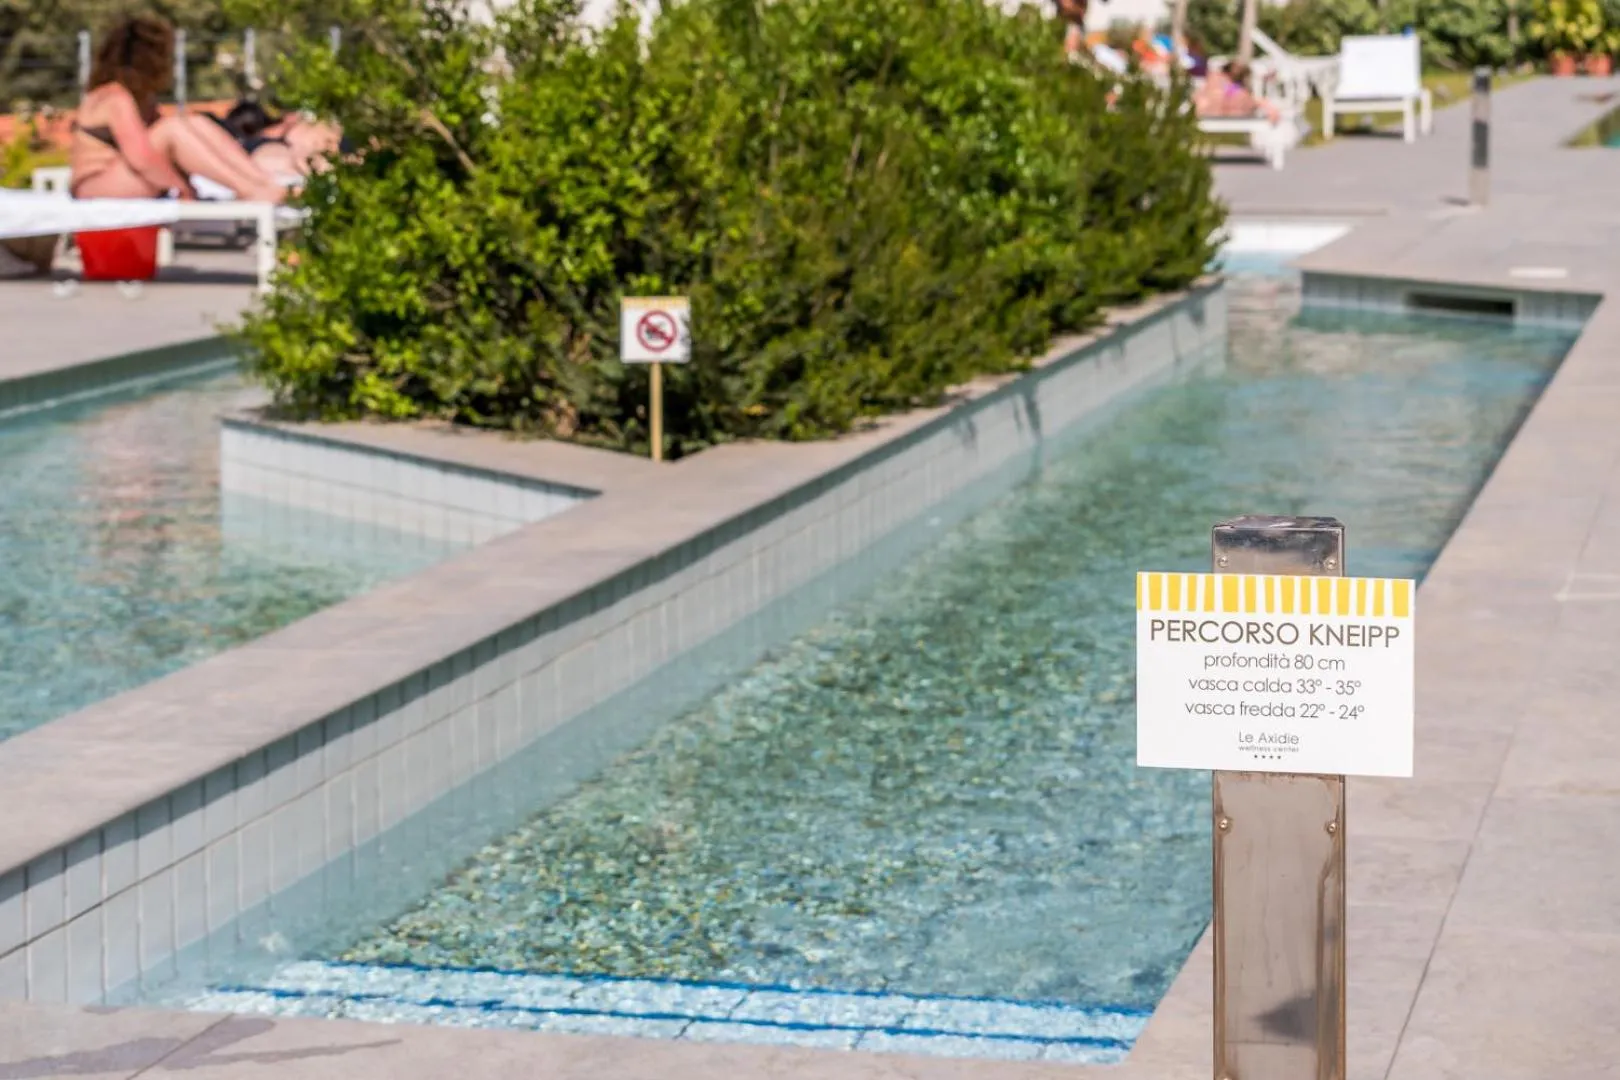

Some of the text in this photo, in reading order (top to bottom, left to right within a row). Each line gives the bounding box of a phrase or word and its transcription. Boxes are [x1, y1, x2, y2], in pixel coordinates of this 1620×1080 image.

[1150, 619, 1401, 648] PERCORSO KNEIPP
[1204, 652, 1346, 671] profondità 80 cm
[1188, 677, 1238, 691] vasca
[1242, 678, 1293, 694] calda
[1185, 701, 1235, 716] vasca
[1239, 701, 1296, 718] fredda
[1238, 731, 1300, 745] Le Axidie
